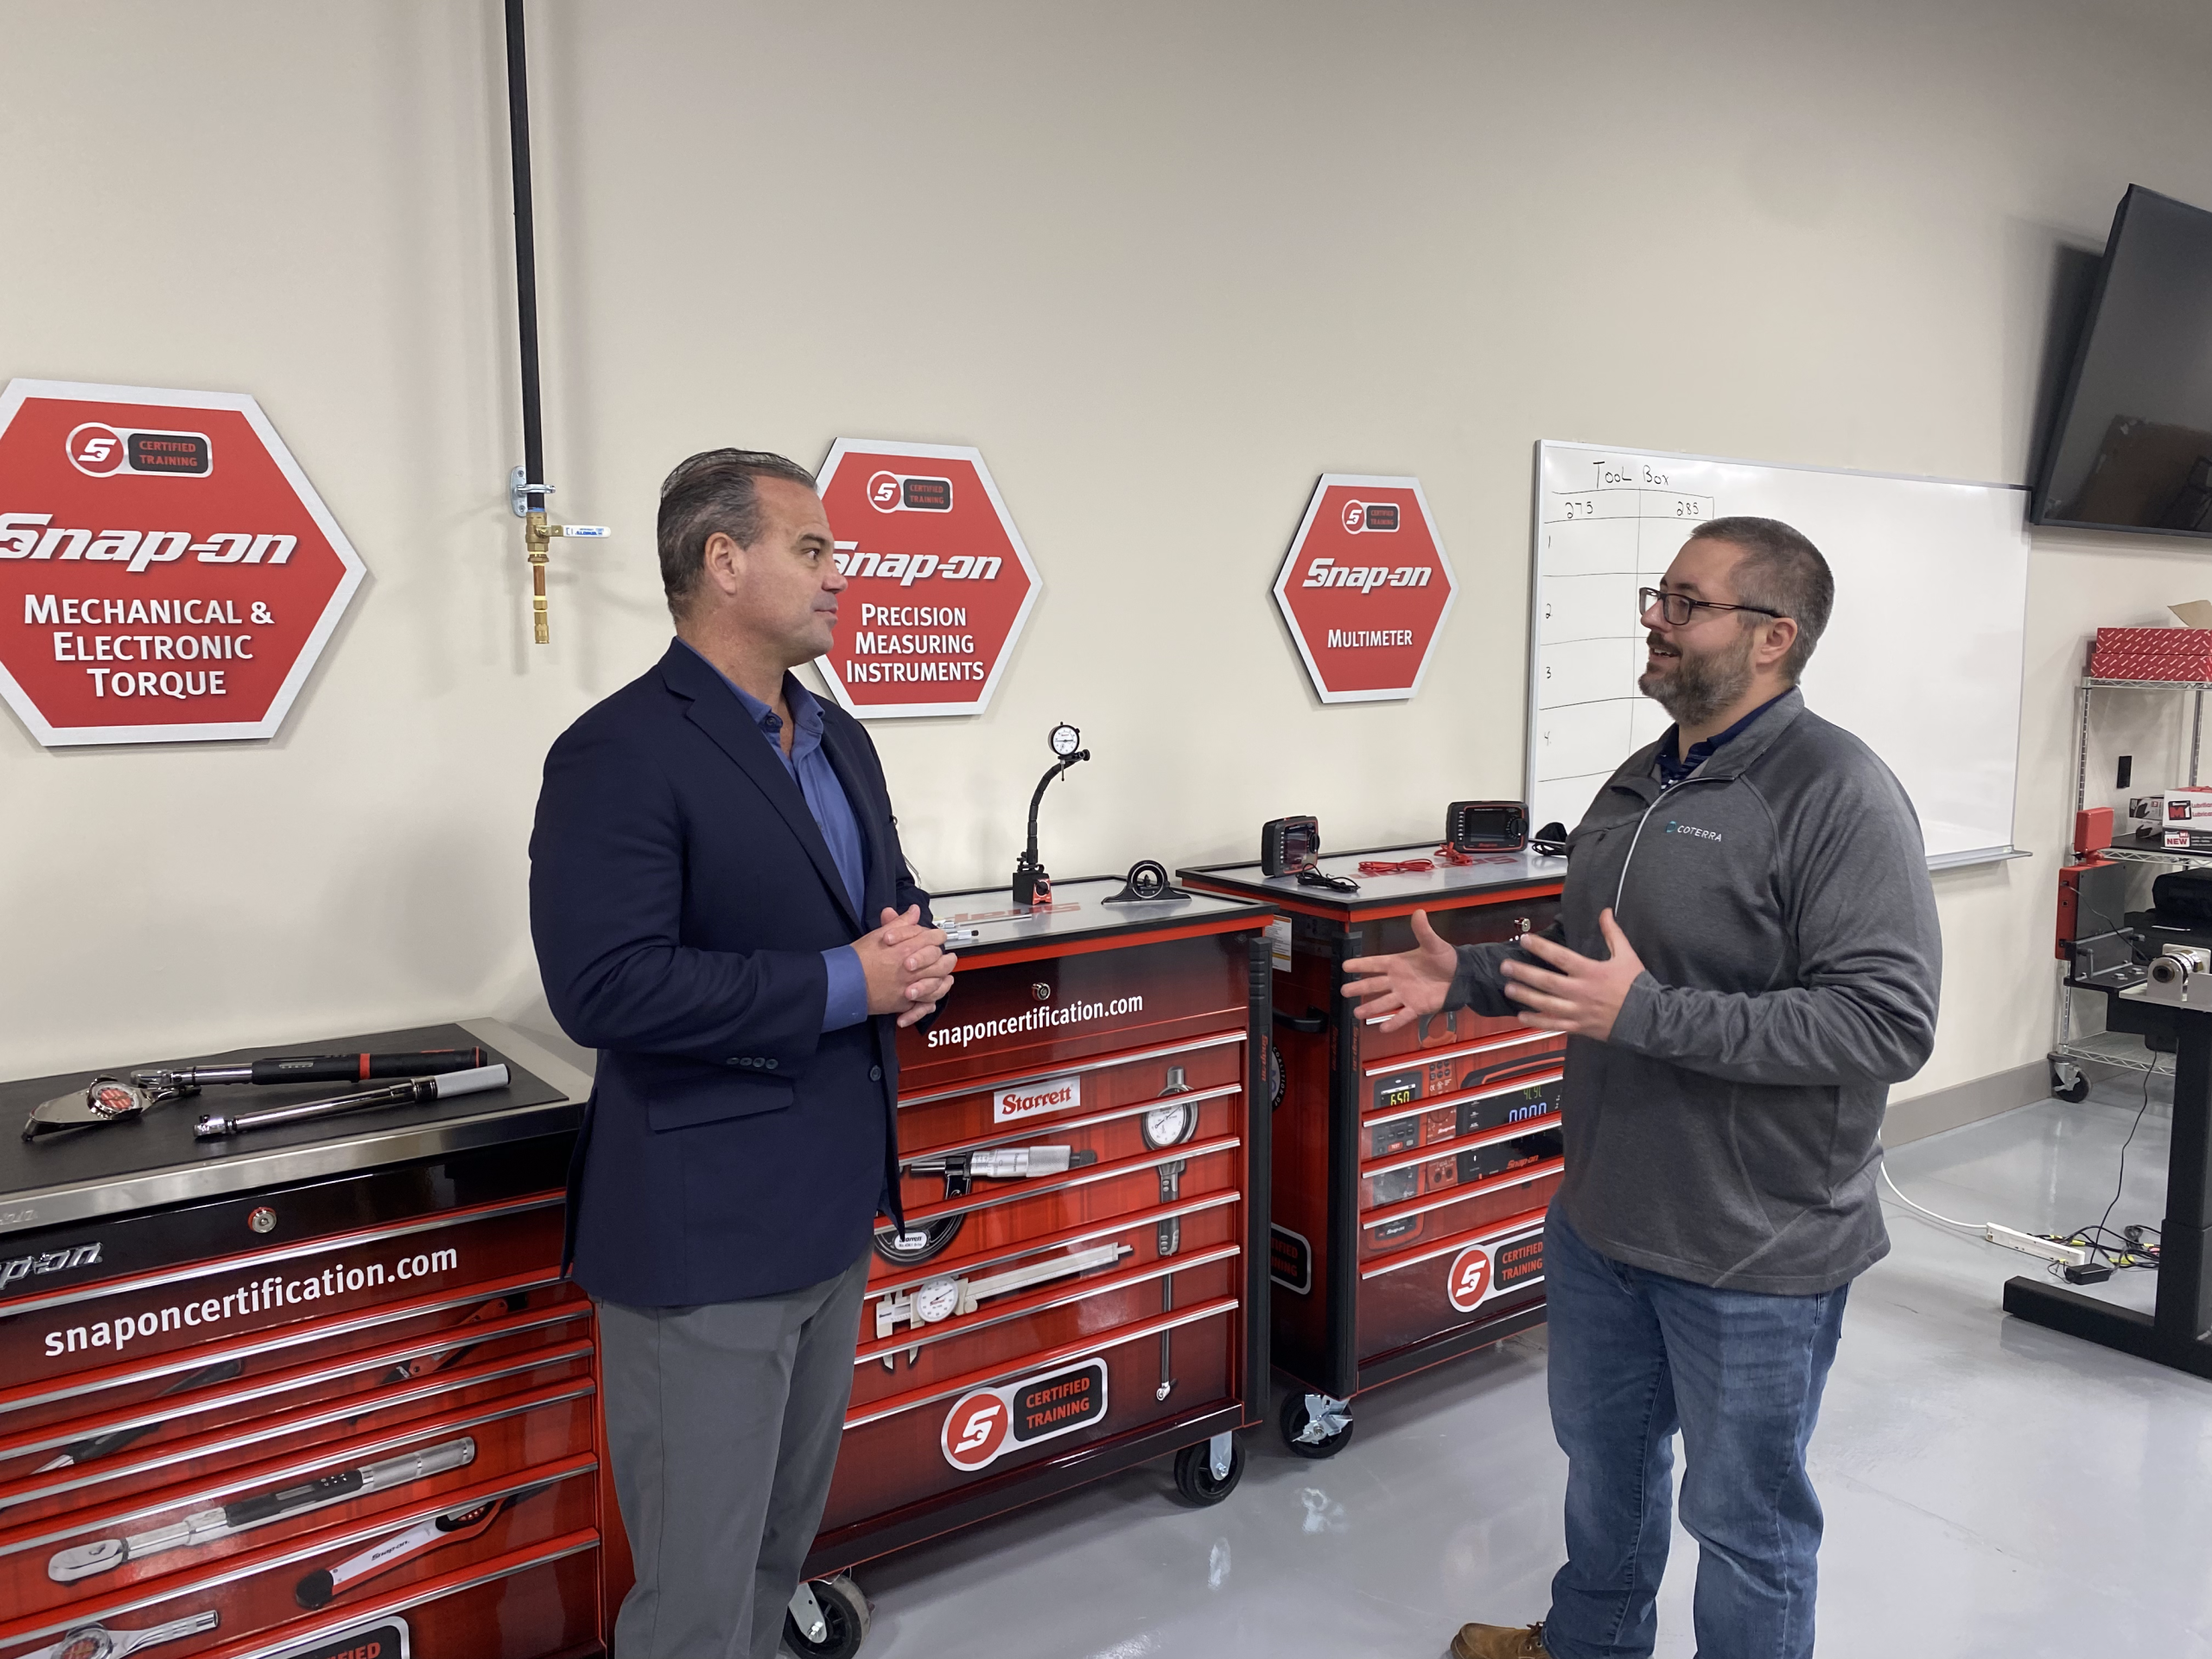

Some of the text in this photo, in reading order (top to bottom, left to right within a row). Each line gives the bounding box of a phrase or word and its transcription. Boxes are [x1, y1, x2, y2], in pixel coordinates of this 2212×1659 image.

[139, 440, 196, 453] CERTIFIED
[139, 454, 198, 467] TRAINING
[910, 484, 944, 493] CERTIFIED
[910, 495, 944, 505] TRAINING
[1565, 501, 1700, 519] 275 285
[0, 512, 298, 572] Snap-on
[1302, 558, 1433, 594] Snap-on
[24, 594, 275, 625] MECHANICAL &
[861, 603, 966, 626] PRECISION
[54, 632, 253, 662] ELECTRONIC
[855, 632, 974, 655] MEASURING
[1328, 629, 1413, 648] MULTIMETER
[846, 660, 984, 683] INSTRUMENTS
[86, 668, 226, 700] TORQUE
[1677, 825, 1722, 842] COTERRA
[927, 995, 1143, 1048] snaponcertification.com
[1002, 1086, 1072, 1116] Starrett
[1502, 1242, 1543, 1264] CERTIFIED
[1502, 1258, 1543, 1281] TRAINING
[44, 1247, 458, 1358] snaponcertification.com
[1026, 1377, 1090, 1409] CERTIFIED
[1026, 1397, 1090, 1429] TRAINING
[372, 1540, 409, 1561] Snap-on
